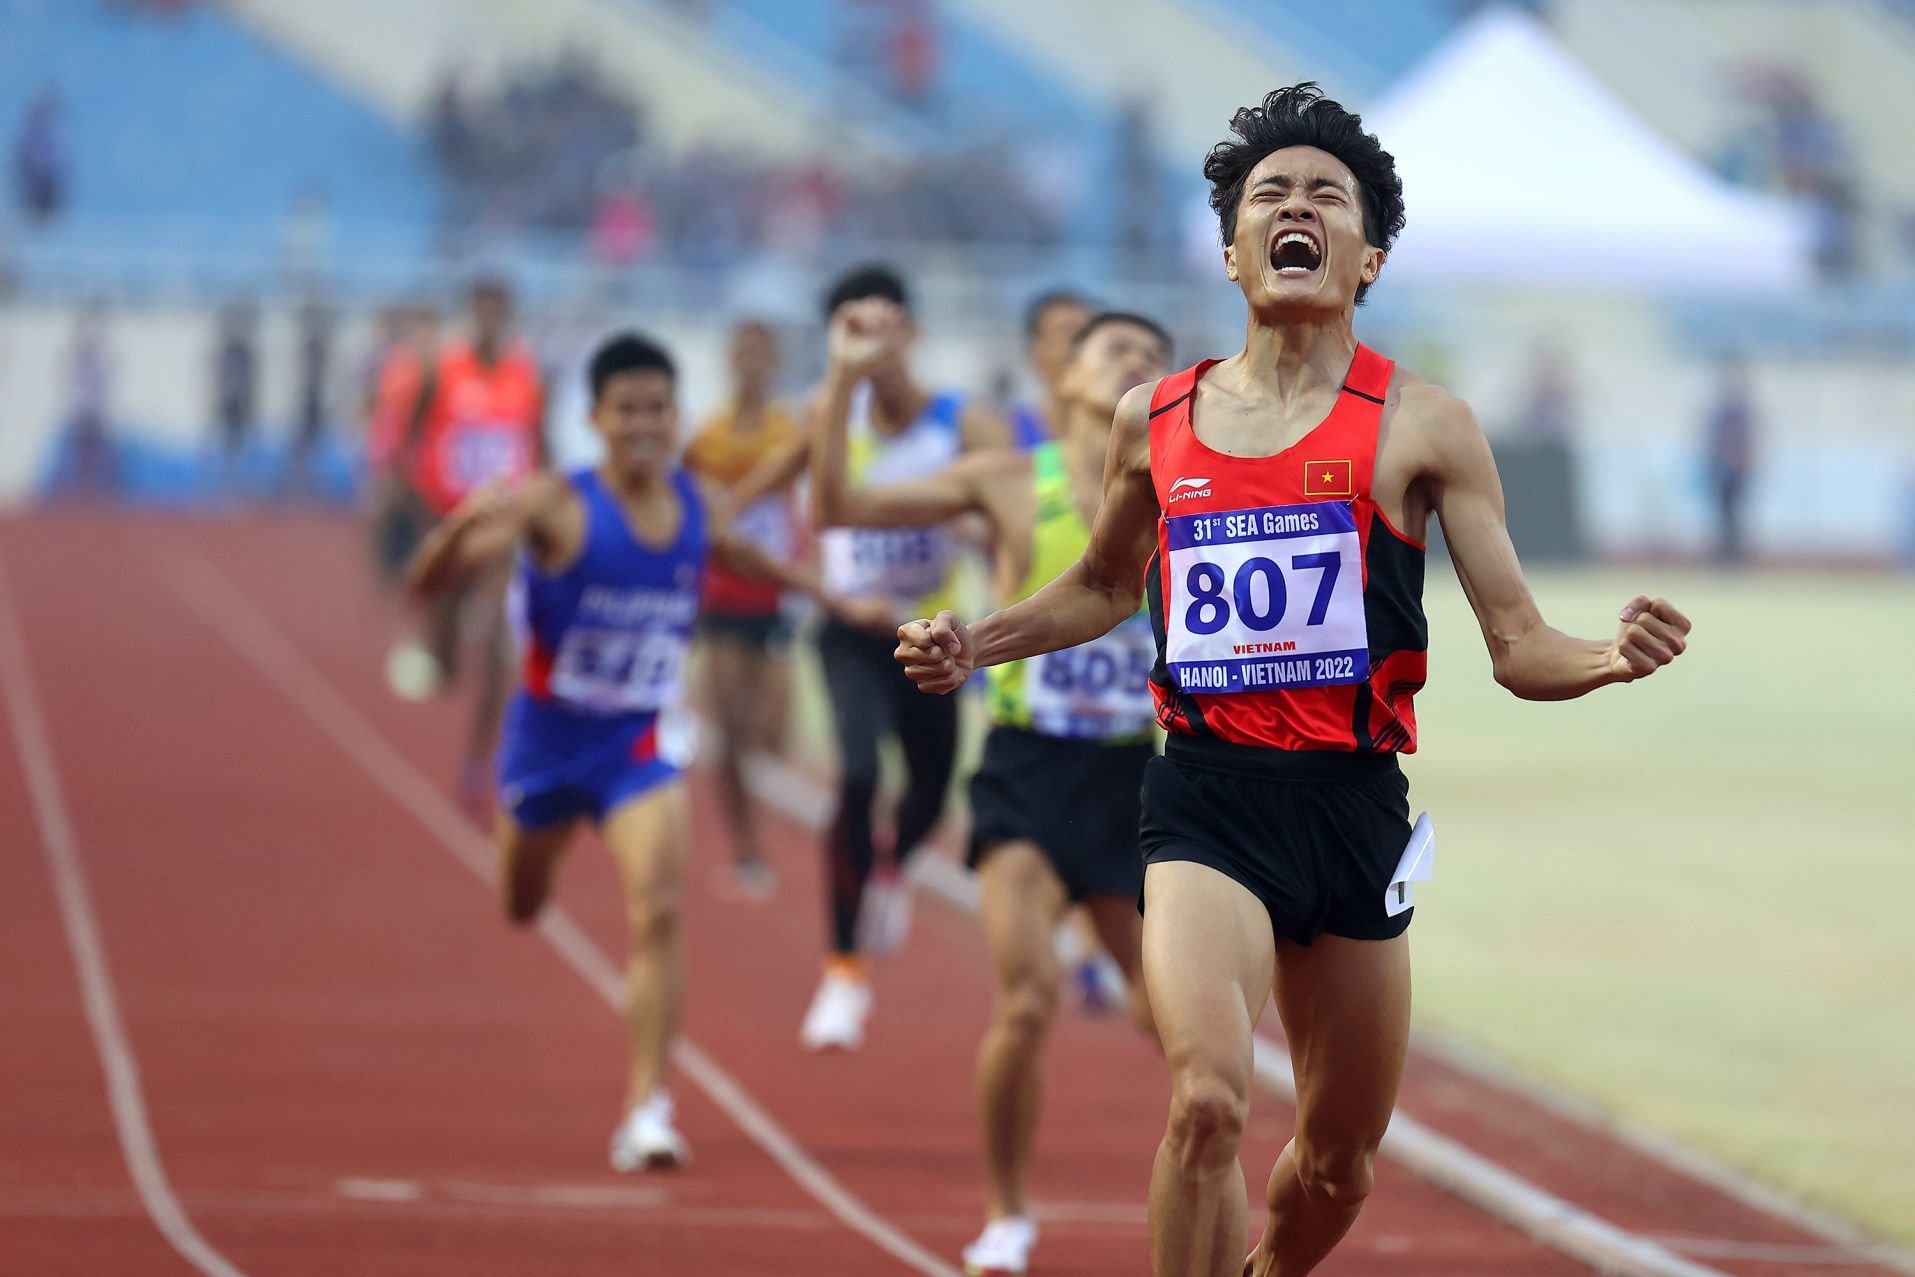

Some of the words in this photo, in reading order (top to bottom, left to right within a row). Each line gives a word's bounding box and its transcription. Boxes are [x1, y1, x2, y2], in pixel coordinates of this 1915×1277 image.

[1168, 488, 1212, 503] LI-NING
[1226, 515, 1259, 538] SEA
[1263, 512, 1319, 534] Games
[1184, 551, 1342, 635] 807
[1233, 641, 1296, 654] VIETNAM
[1180, 666, 1227, 688] HANOI
[1241, 660, 1312, 686] VIETNAM
[1315, 656, 1354, 680] 2022
